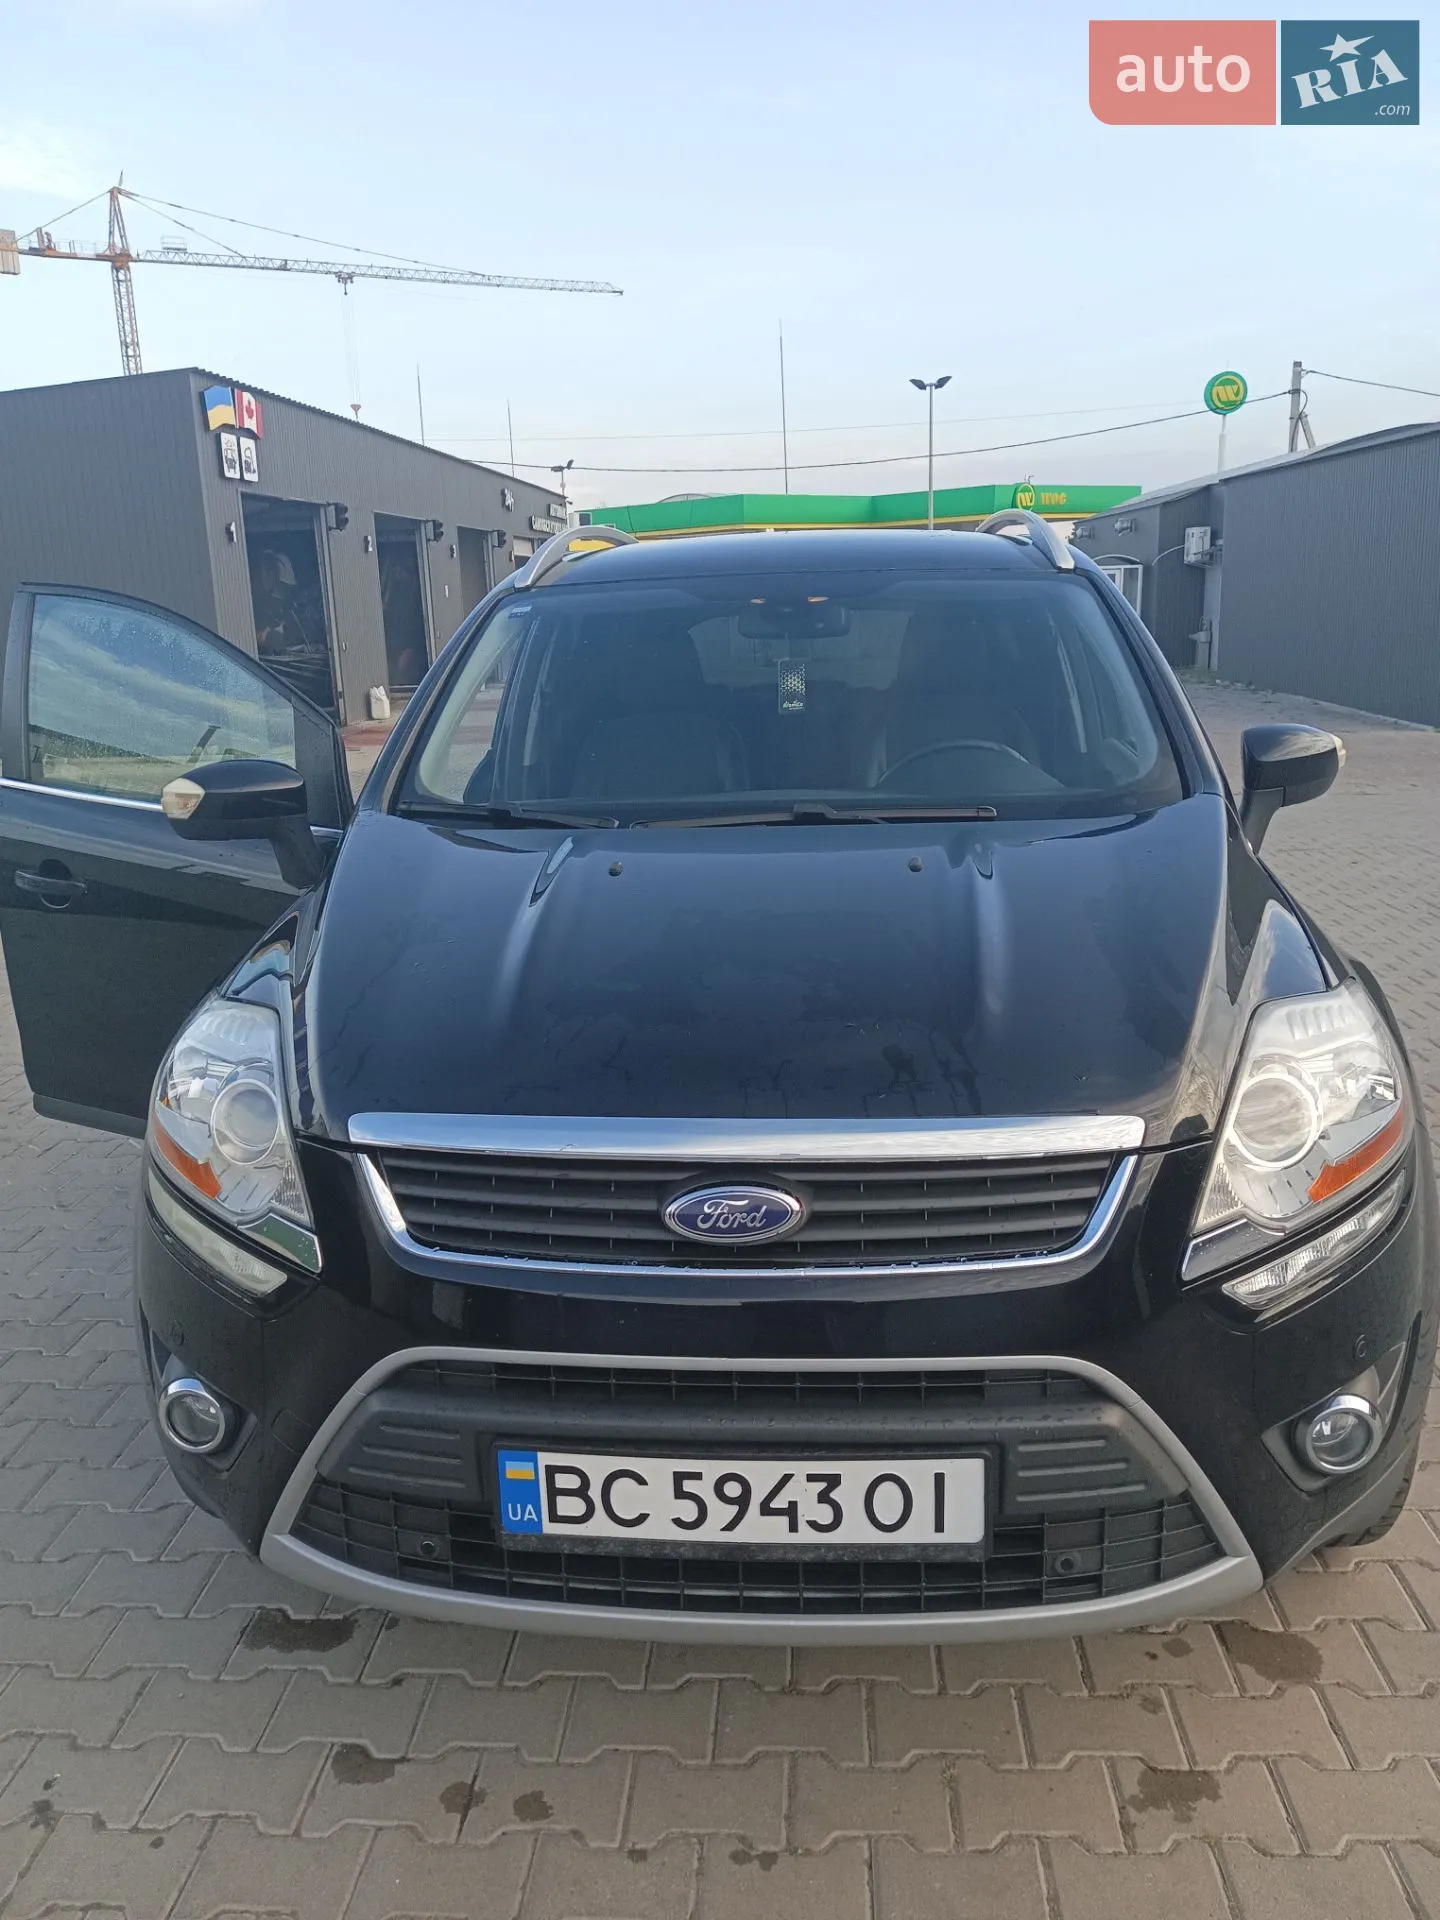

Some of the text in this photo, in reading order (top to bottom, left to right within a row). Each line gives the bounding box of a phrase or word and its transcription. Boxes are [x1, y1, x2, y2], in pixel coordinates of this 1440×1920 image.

[696, 1199, 768, 1230] Ford
[507, 1503, 538, 1522] UA
[544, 1464, 651, 1529] BC
[670, 1470, 844, 1534] 5943
